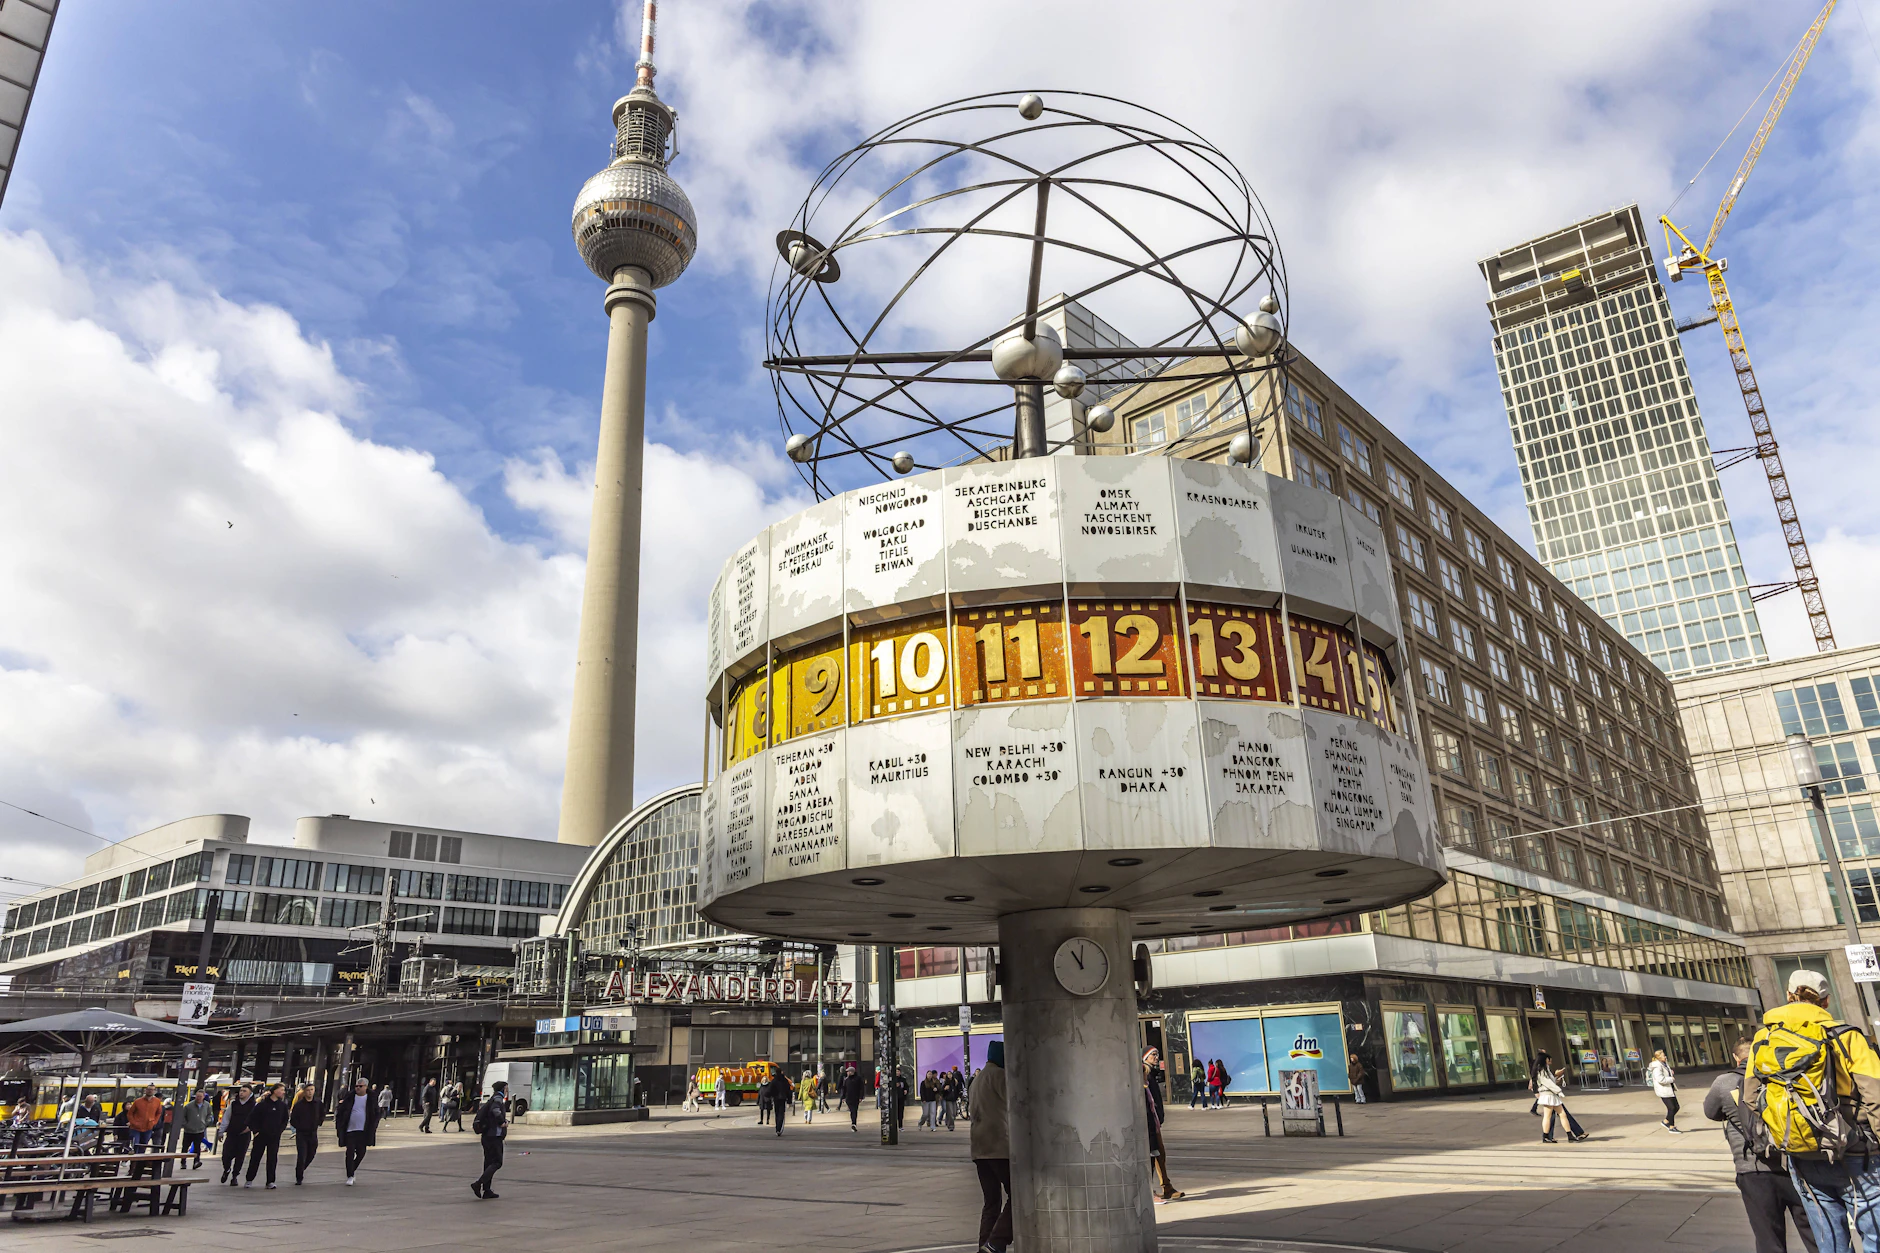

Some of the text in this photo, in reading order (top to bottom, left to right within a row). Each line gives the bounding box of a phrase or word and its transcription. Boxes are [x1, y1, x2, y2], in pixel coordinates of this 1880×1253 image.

[955, 478, 1046, 497] JEKATERINBURG
[1100, 489, 1131, 499] OMSK
[859, 488, 906, 506] NISCHNIJ
[875, 495, 928, 514] NOWGOROD
[967, 492, 1035, 508] ASCHGABAT
[1187, 492, 1259, 510] KRASNOJARSK
[974, 505, 1029, 519] BISCHKEK
[1095, 502, 1140, 511] ALMATY
[968, 517, 1038, 532] DUSCHANBE
[1084, 513, 1152, 523] TASCHKENT
[863, 519, 924, 540] WOLGOGRAD
[1082, 526, 1157, 535] NOWOSIBIRSK
[1296, 523, 1327, 540] IRKUTSK
[784, 532, 828, 558] MURMANSK
[881, 534, 907, 549] BAKU
[779, 541, 834, 572] ST. PETERSBURG
[879, 547, 908, 560] TIFLIS
[1291, 544, 1338, 566] ULAN-BATOR
[790, 558, 822, 578] MOSKAU
[875, 557, 913, 573] ERIWAN
[734, 610, 757, 632] BUKAREST
[975, 619, 1042, 682] 11
[1080, 614, 1163, 674] 12
[1190, 618, 1261, 680] 13
[871, 632, 946, 698] 10
[1281, 631, 1336, 693] 14
[805, 656, 840, 716] 9
[1348, 650, 1381, 712] 15
[753, 680, 775, 738] 8
[966, 747, 991, 758] NEW
[1000, 744, 1035, 756] DELHI
[1238, 742, 1272, 752] HANOI
[1330, 737, 1358, 751] PEKING
[776, 748, 814, 766] TEHERAN
[869, 756, 904, 771] KABUL
[987, 758, 1045, 771] KARACHI
[1233, 755, 1281, 767] BANGKOK
[1324, 750, 1367, 766] SHANGHAI
[790, 759, 821, 774] BAGDAD
[1099, 768, 1152, 779] RANGUN
[1332, 764, 1364, 777] MANILA
[732, 767, 752, 784] ANKARA
[794, 773, 817, 787] ADEN
[871, 767, 929, 784] MAURITIUS
[973, 773, 1028, 786] COLOMBO
[1223, 768, 1294, 782] PHNOM PENH
[731, 778, 752, 796] ISTANBUL
[1121, 782, 1167, 793] DHAKA
[1236, 783, 1286, 795] JAKARTA
[1338, 778, 1362, 790] PERTH
[733, 792, 748, 807] ATHEN
[790, 786, 820, 800] SANAA
[1331, 791, 1373, 804] HONGKONG
[777, 798, 833, 816] ADDIS ABEBA
[1324, 802, 1383, 819] KUALA LUMPUR
[727, 815, 753, 834] JERUSALEM
[777, 811, 833, 829] MOGADISCHU
[1336, 817, 1376, 832] SINGAPUR
[732, 830, 747, 844] BEIRUT
[776, 824, 833, 842] DARESSALAM
[726, 841, 752, 858] DAMASKUS
[772, 836, 838, 857] ANTANANARIVO
[789, 853, 820, 868] KUWAIT
[604, 970, 852, 1003] ALEXANDERPLATZ
[537, 1020, 542, 1033] U
[582, 1017, 590, 1029] U
[1295, 1035, 1316, 1050] dm
